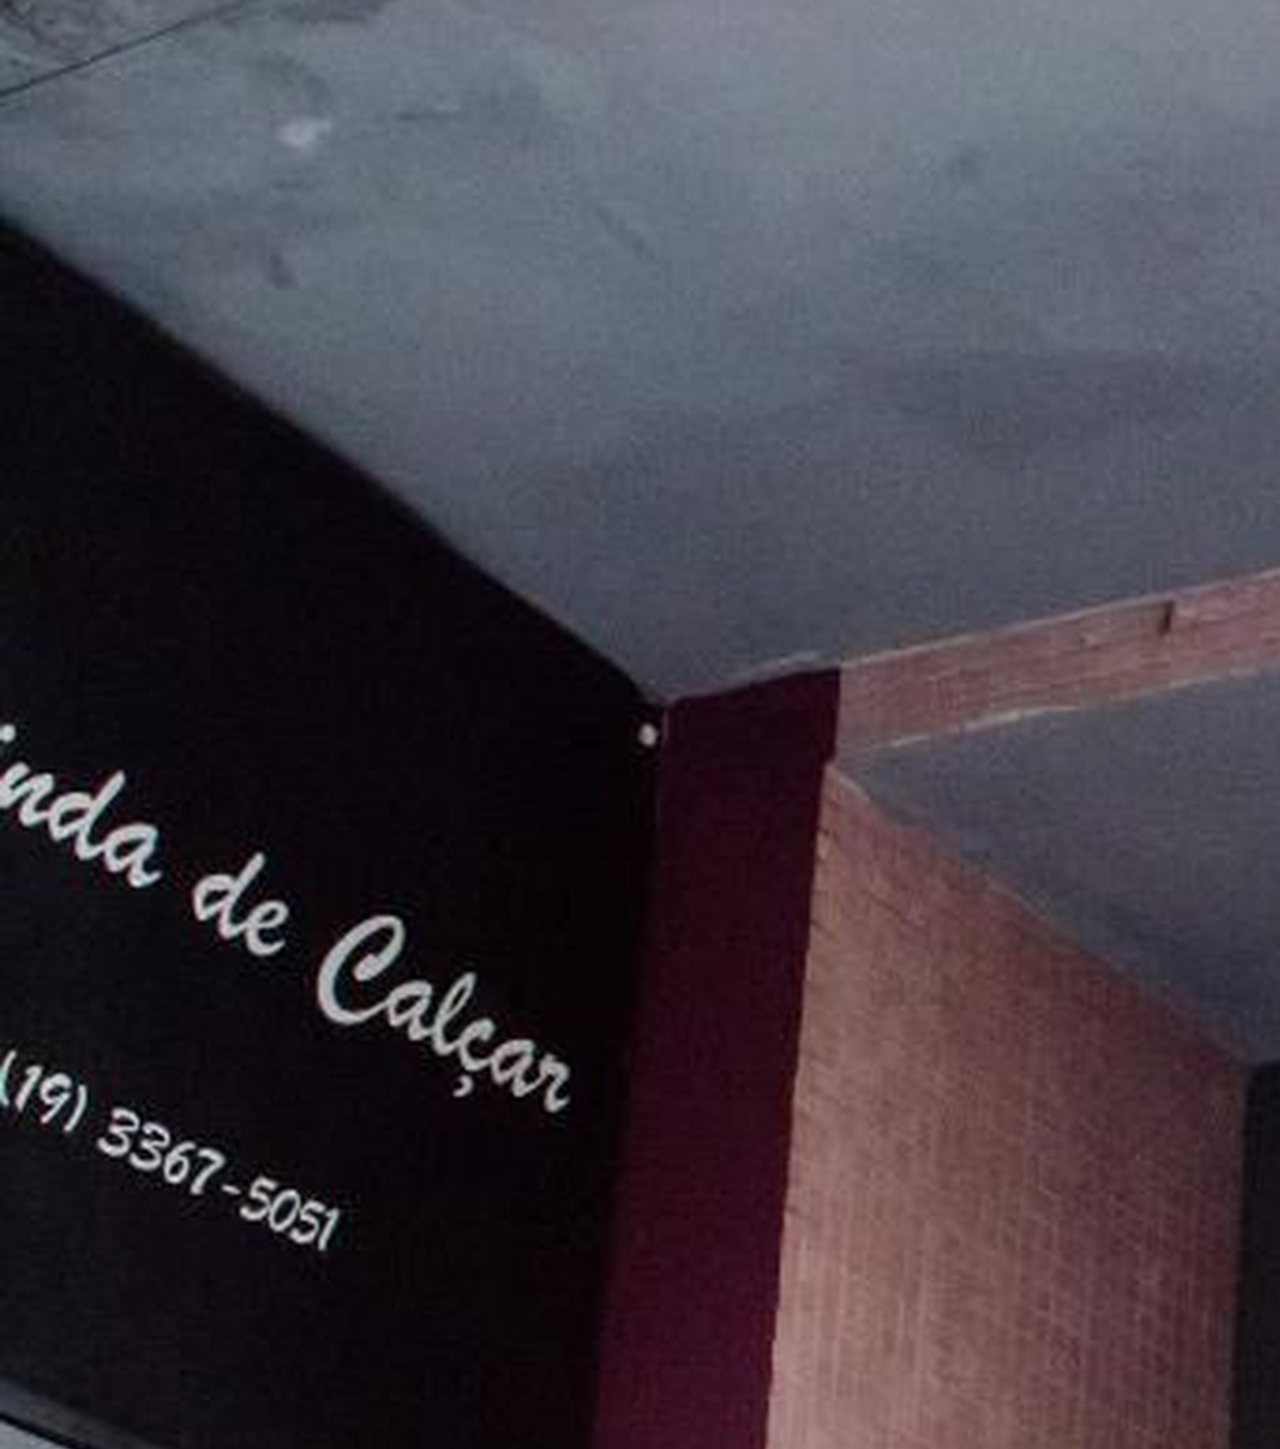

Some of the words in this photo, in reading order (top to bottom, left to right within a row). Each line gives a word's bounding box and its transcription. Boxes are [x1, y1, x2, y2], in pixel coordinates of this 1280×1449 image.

[0, 724, 161, 888] nda
[193, 853, 289, 956] de
[317, 915, 570, 1112] Calçar
[0, 1050, 87, 1132] (19)
[98, 1108, 340, 1251] 3367-5051
